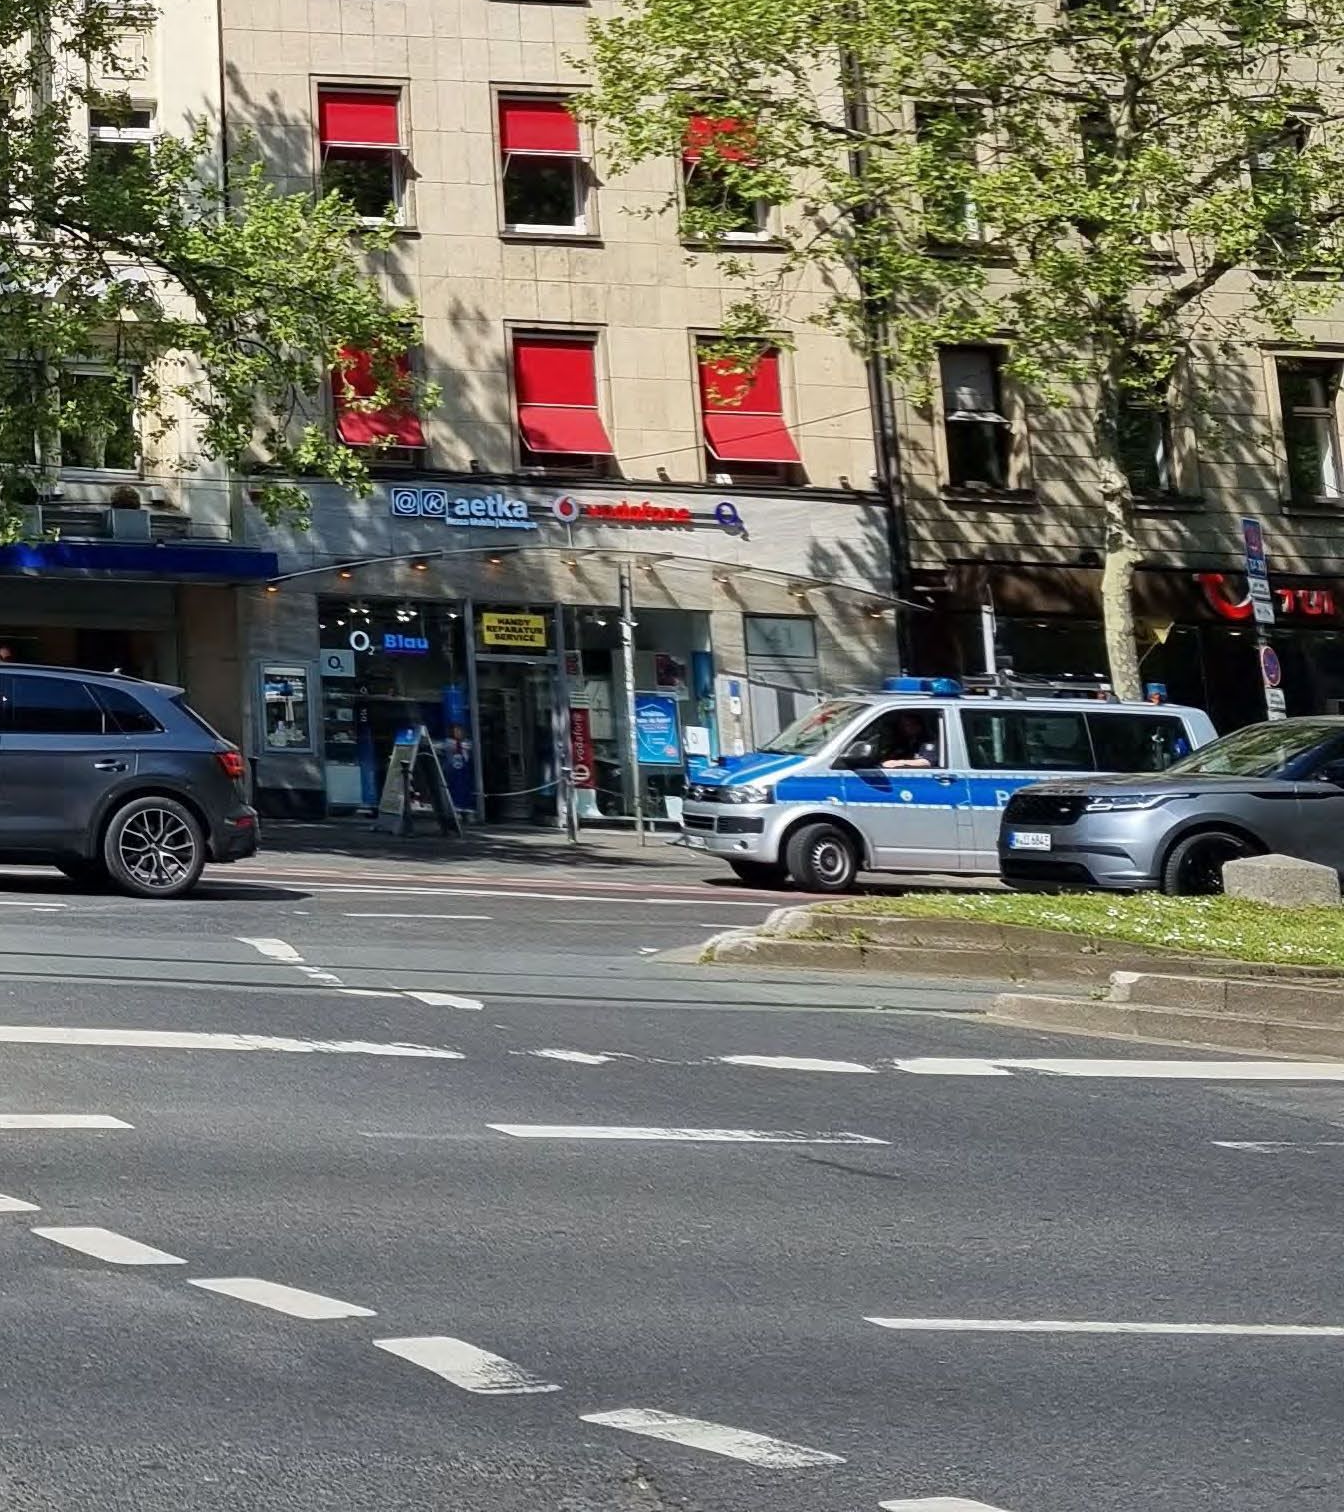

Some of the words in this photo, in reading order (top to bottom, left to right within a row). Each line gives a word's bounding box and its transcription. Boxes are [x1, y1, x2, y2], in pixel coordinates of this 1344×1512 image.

[454, 493, 529, 519] aetka
[585, 500, 693, 521] vodafone
[1274, 588, 1336, 615] TUI
[384, 633, 430, 650] Blau
